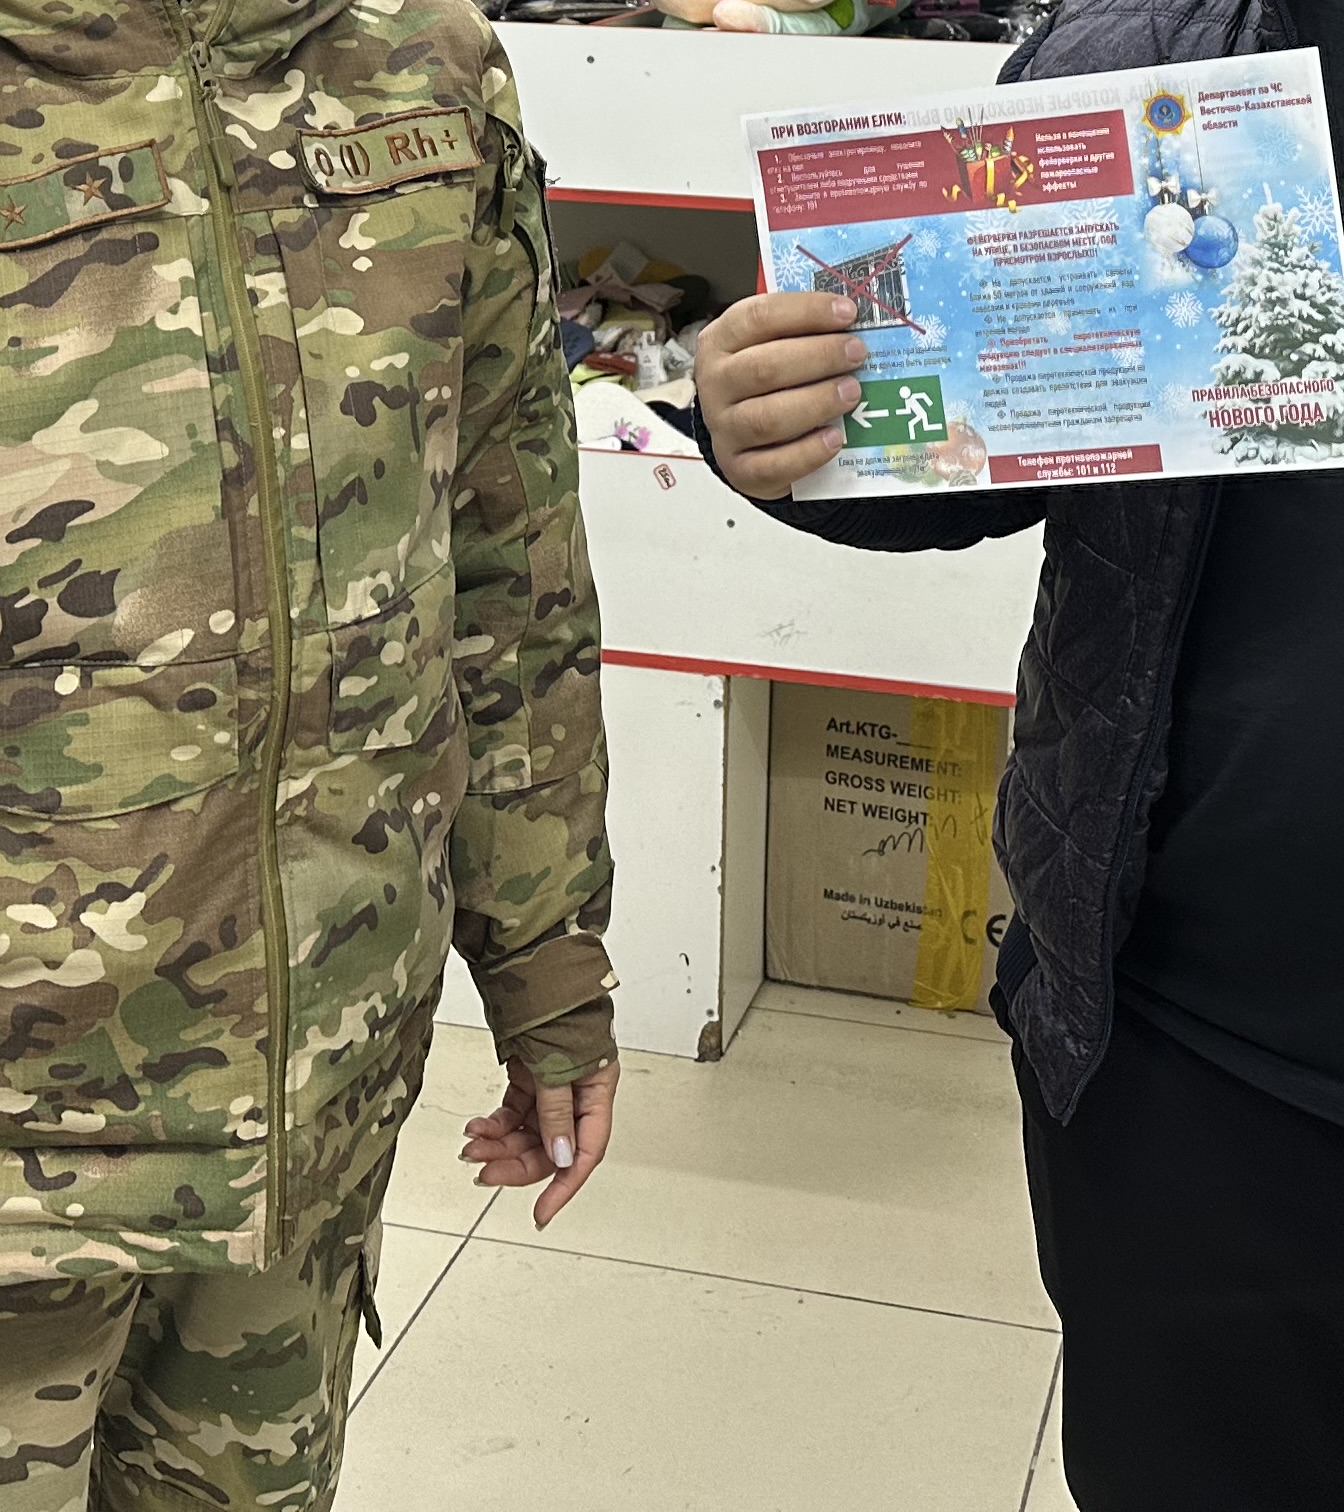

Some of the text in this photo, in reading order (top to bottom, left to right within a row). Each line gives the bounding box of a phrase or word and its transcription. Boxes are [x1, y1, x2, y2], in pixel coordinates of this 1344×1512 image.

[1198, 83, 1283, 103] Департамент по ЧС
[1200, 95, 1312, 115] Восточно-Казахстанской
[771, 112, 906, 139] ПРИ ВОЗГОРАНИИ ЕЛКИ:
[1202, 120, 1238, 131] области
[384, 127, 458, 166] Rh+
[1037, 143, 1086, 154] использовать
[1090, 152, 1114, 163] другие
[1043, 182, 1076, 193] эффекты
[1019, 226, 1073, 239] РАЗРЕШАЕТСЯ
[1075, 222, 1120, 234] ЗАПУСКАТЬ
[972, 246, 982, 257] НА
[1020, 238, 1070, 251] БЕЗОПАСНОМ
[1100, 235, 1117, 245] ПОД
[993, 253, 1046, 267] ПРИСМОТРОМ
[1000, 336, 1048, 347] Приобретать
[1022, 348, 1051, 358] следует
[1192, 379, 1334, 402] ПРАВИЛА БЕЗОПАСНОГО
[1208, 402, 1324, 428] НОВОГО ГОДА
[1017, 448, 1133, 468] Телефон противопожарной
[1076, 465, 1091, 475] 101
[1093, 466, 1098, 474] и
[1100, 463, 1116, 473] 112
[826, 743, 962, 777] MEASUREMENT:
[825, 770, 962, 805] GROSS WEIGHT:
[824, 797, 933, 827] NET WEIGHT:
[824, 888, 942, 917] Made in Uzbekistan
